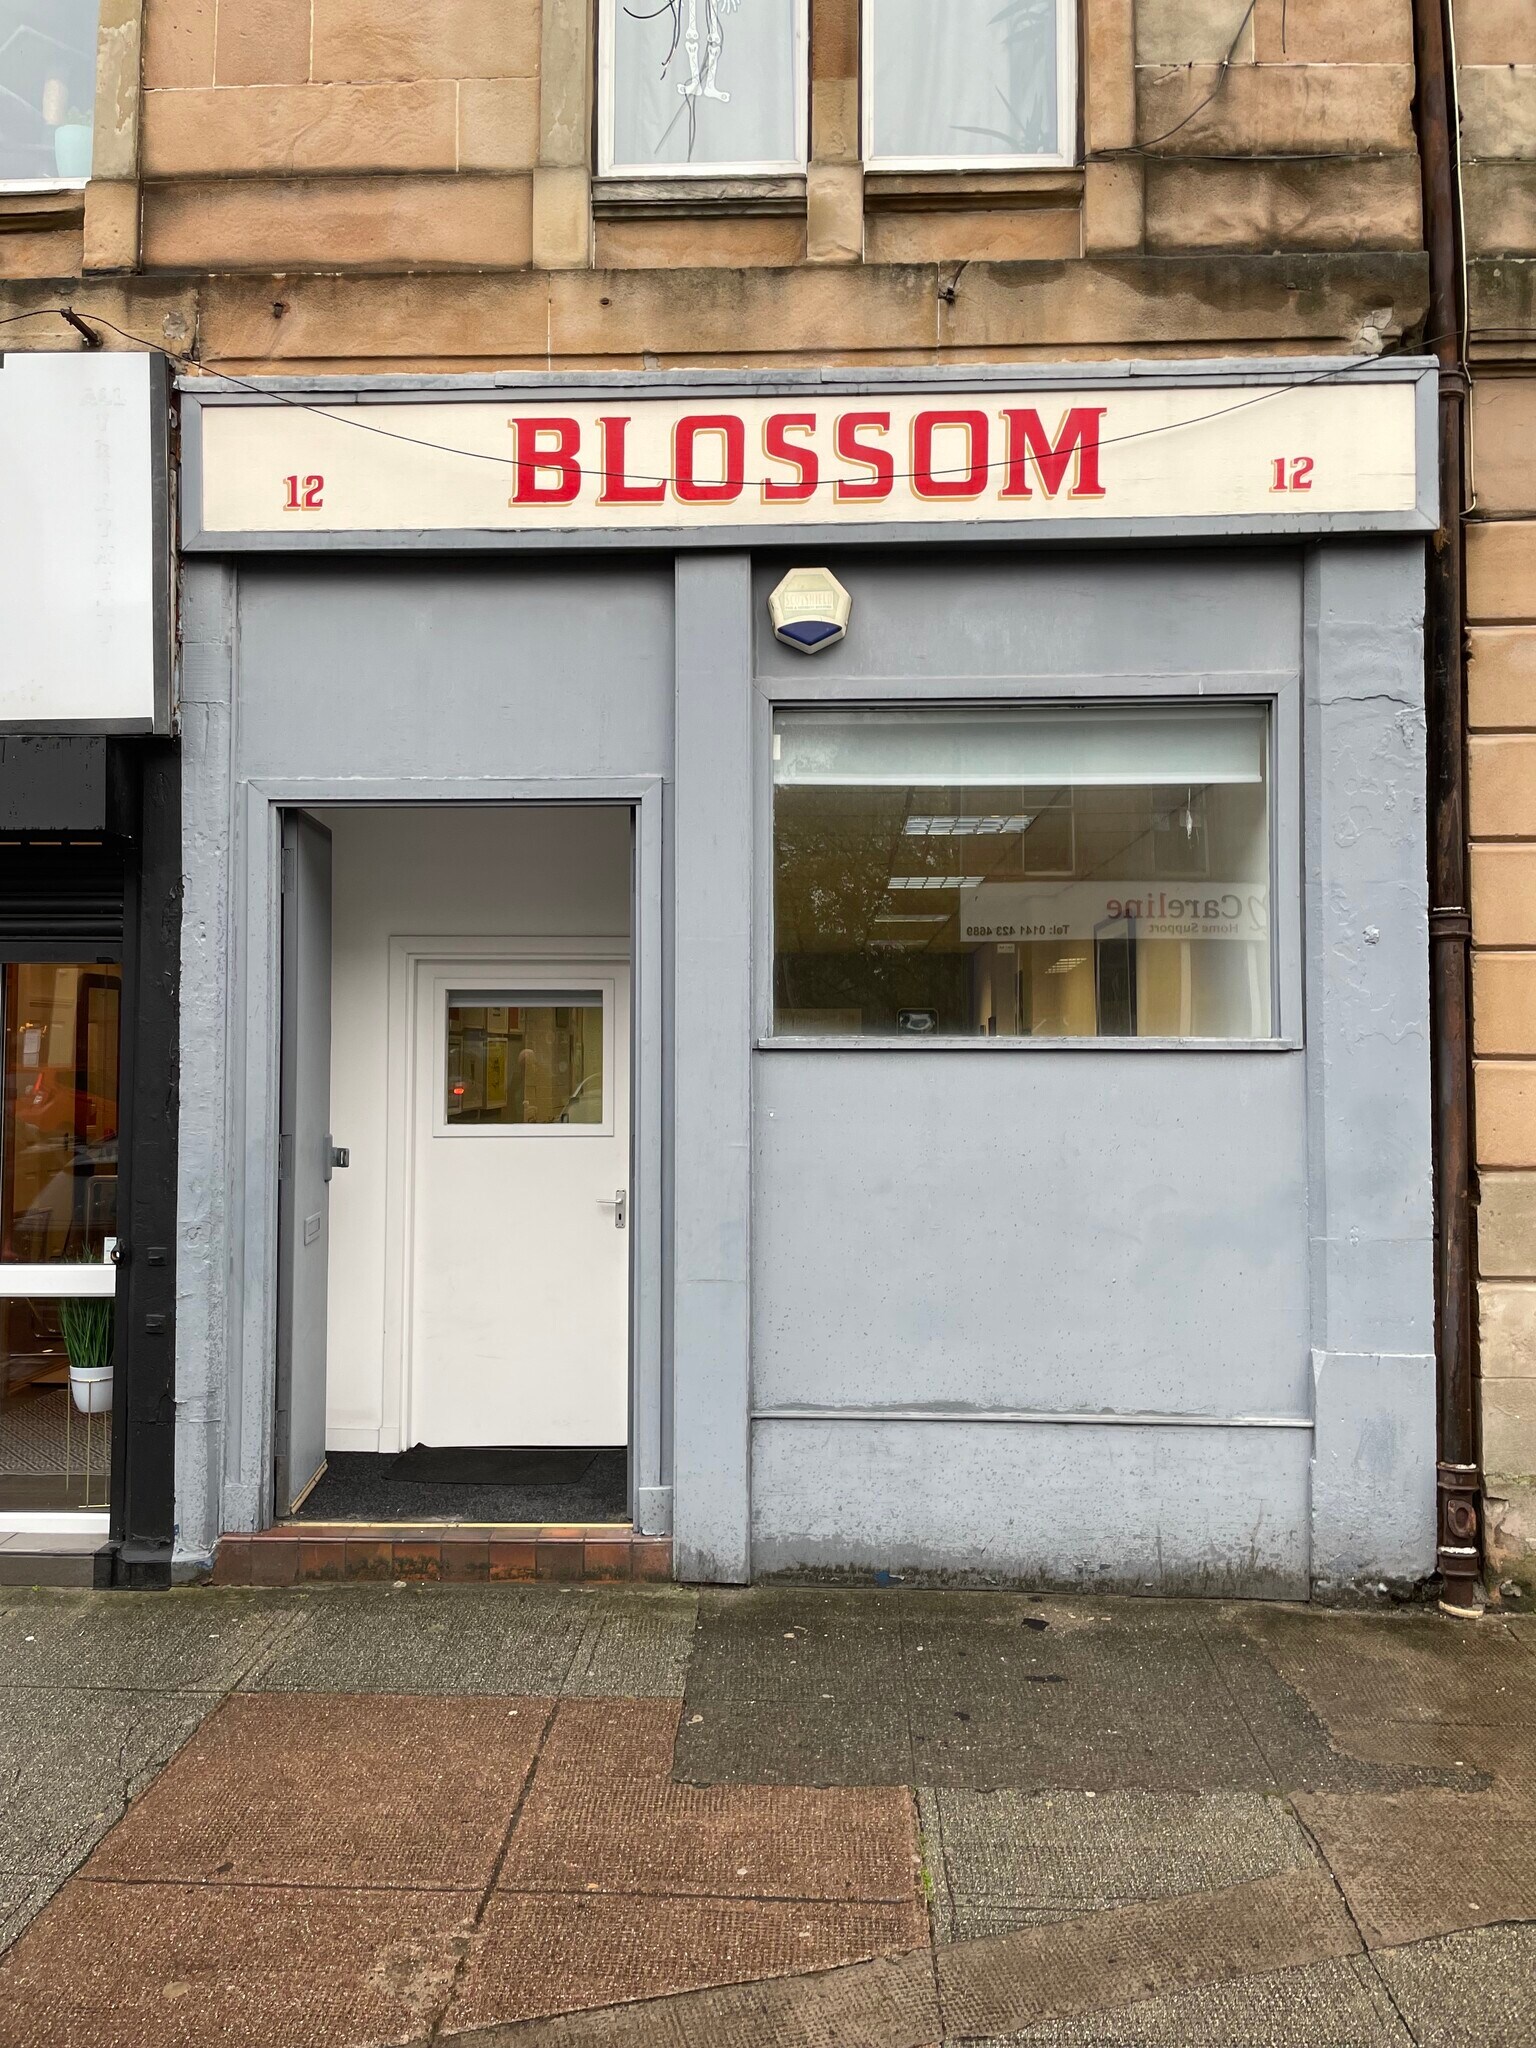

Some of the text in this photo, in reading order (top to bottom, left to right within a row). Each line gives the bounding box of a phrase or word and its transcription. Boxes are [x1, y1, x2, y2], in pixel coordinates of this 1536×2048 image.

[508, 407, 1107, 506] BLOSSOM
[283, 475, 324, 511] 12
[1269, 457, 1313, 493] 12
